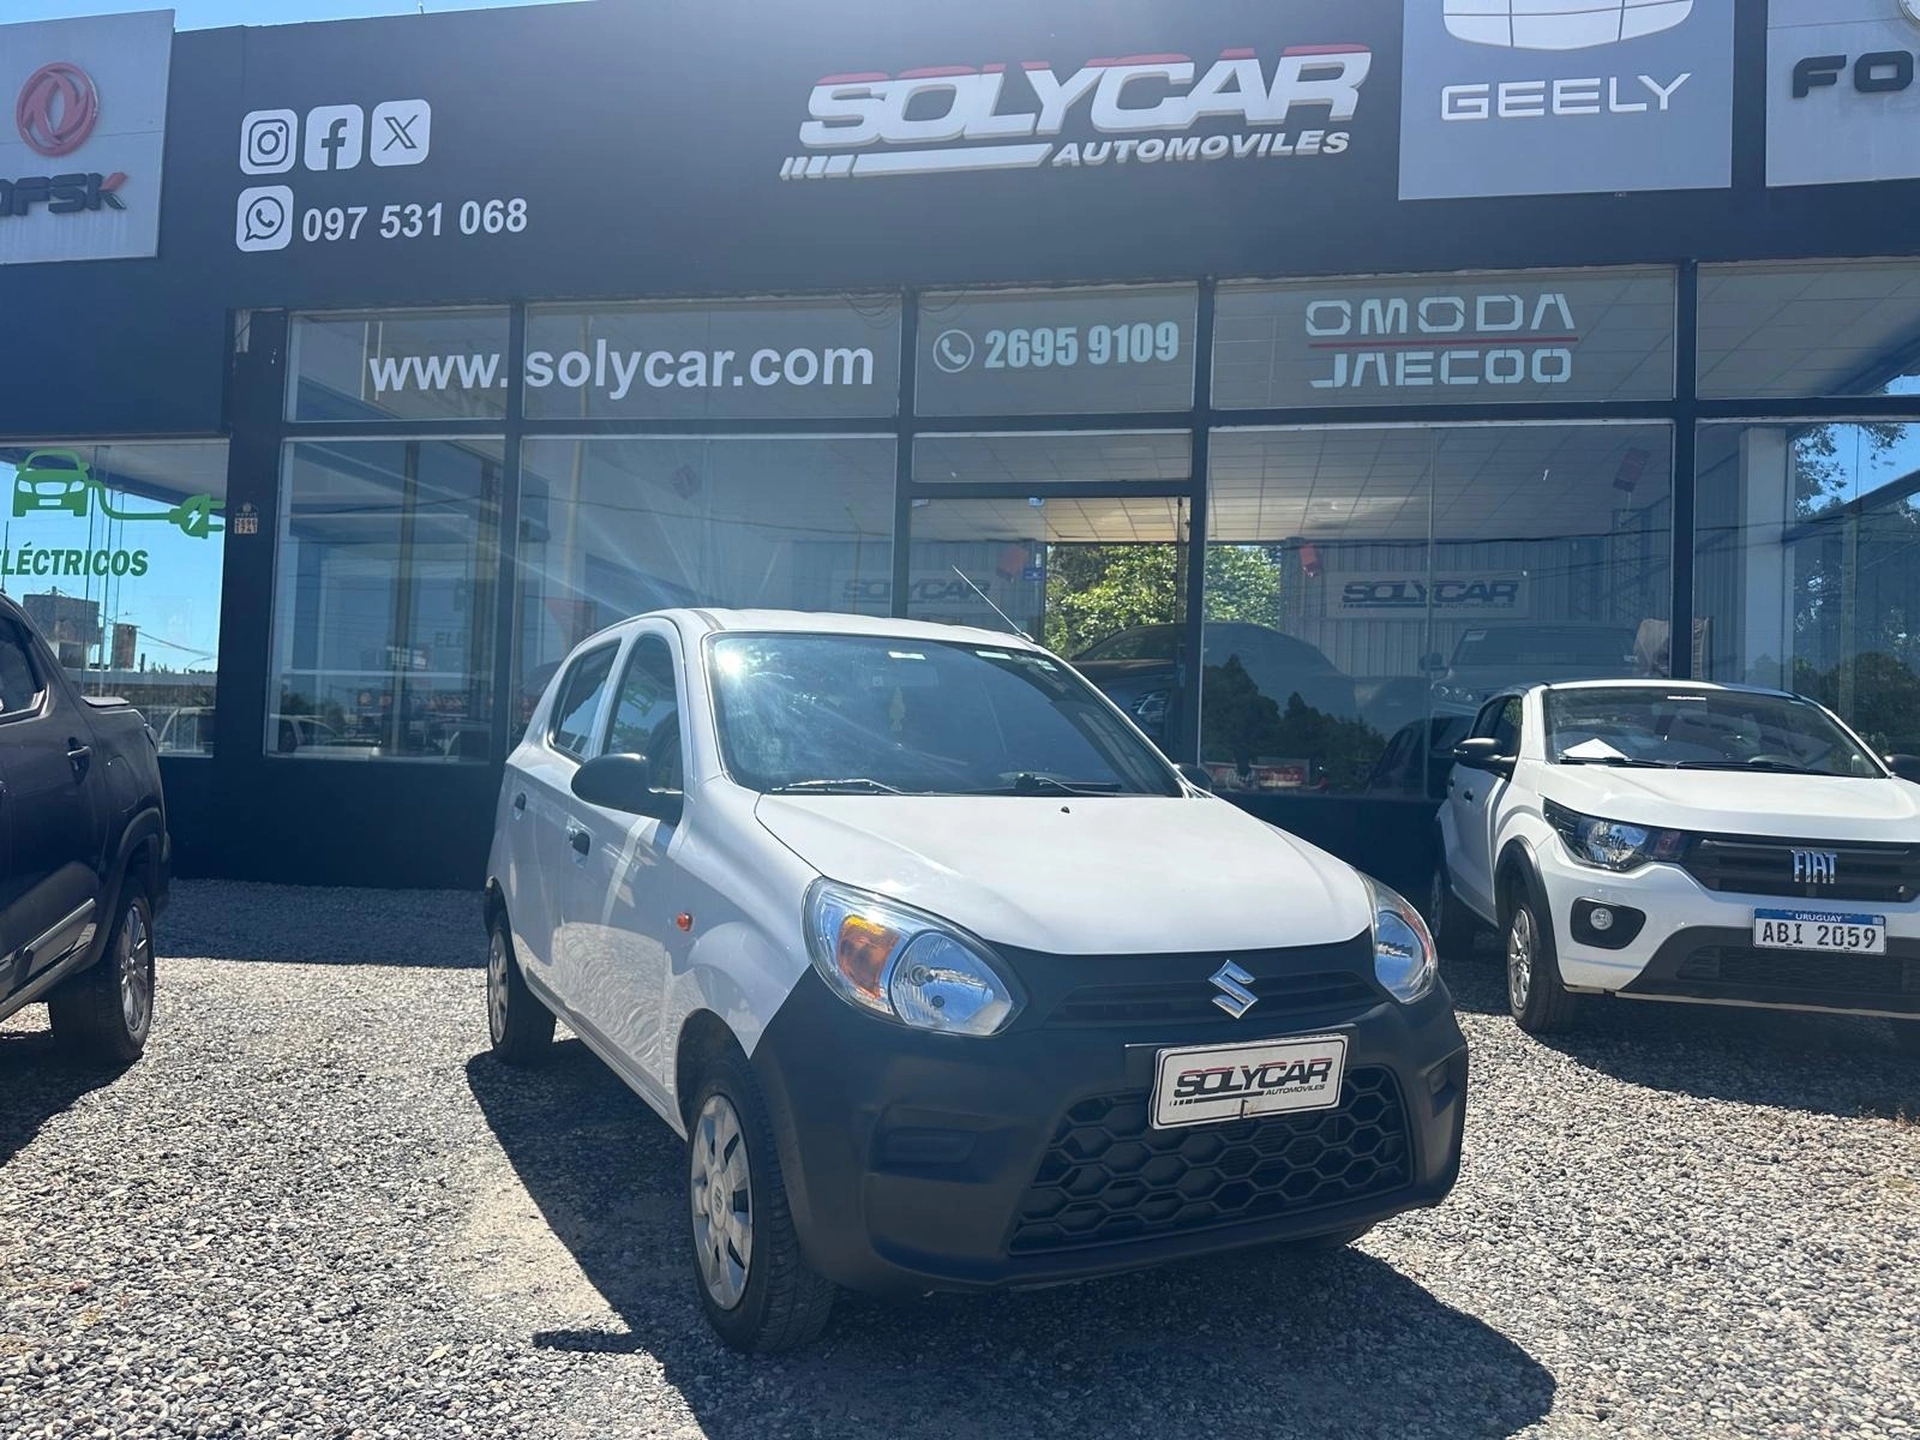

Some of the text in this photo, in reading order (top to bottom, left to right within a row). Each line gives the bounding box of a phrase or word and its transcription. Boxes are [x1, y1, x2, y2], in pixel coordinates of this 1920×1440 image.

[1792, 50, 1920, 98] FO
[800, 44, 1371, 147] SOLYCAR
[1441, 73, 1692, 121] GEELY
[1052, 130, 1350, 168] AUTOMOVILES
[302, 198, 528, 242] 097 531 068
[1306, 293, 1576, 336] OMODA
[984, 321, 1179, 369] 2695 9109
[1309, 347, 1572, 388] JAECOO
[0, 541, 148, 577] LÉCTRICOS
[1342, 579, 1519, 602] SOLYCAR
[1791, 849, 1837, 884] FIAT
[1762, 921, 1876, 949] ABI 2059
[1795, 913, 1843, 923] URUGUAY
[1174, 1057, 1333, 1098] SOLYCAR
[1265, 1083, 1326, 1096] AUTOMOVILES
